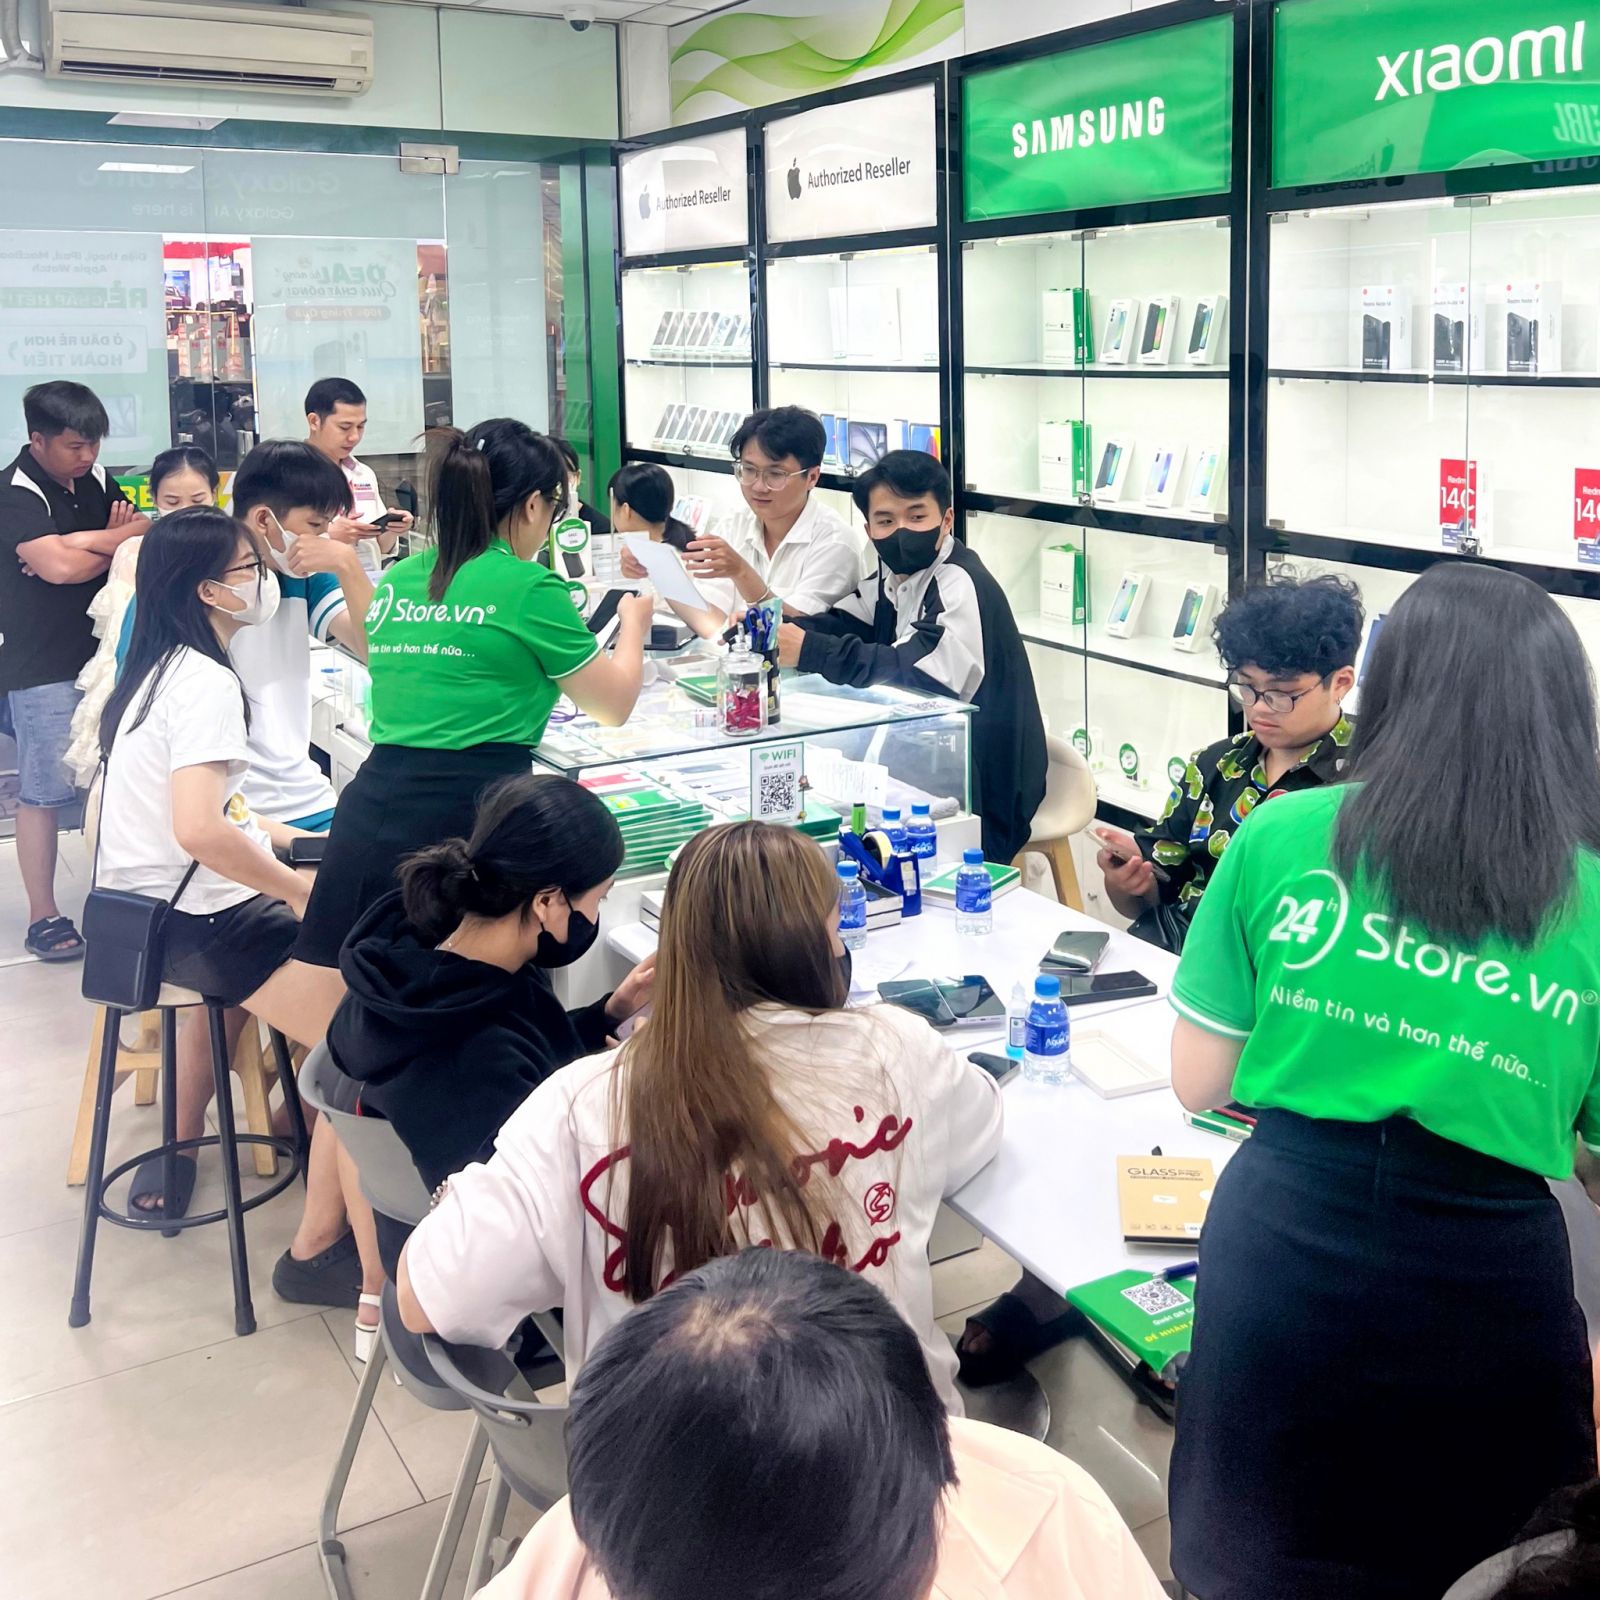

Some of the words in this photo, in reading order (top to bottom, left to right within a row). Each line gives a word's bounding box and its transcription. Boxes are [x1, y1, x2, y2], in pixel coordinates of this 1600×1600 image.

[1012, 96, 1165, 158] SAMSUNG
[808, 163, 862, 189] Authorized
[865, 158, 911, 180] Reseller
[656, 190, 698, 212] Authorized
[699, 186, 731, 206] Reseller
[772, 749, 796, 761] WIFI
[1269, 983, 1320, 1014] Niềm
[1325, 1001, 1355, 1023] tin
[1363, 1011, 1391, 1033] và
[1398, 1017, 1441, 1048] hơn
[1448, 1033, 1491, 1062] thế
[1491, 1053, 1548, 1088] nữa...
[1127, 1167, 1177, 1177] GLASS
